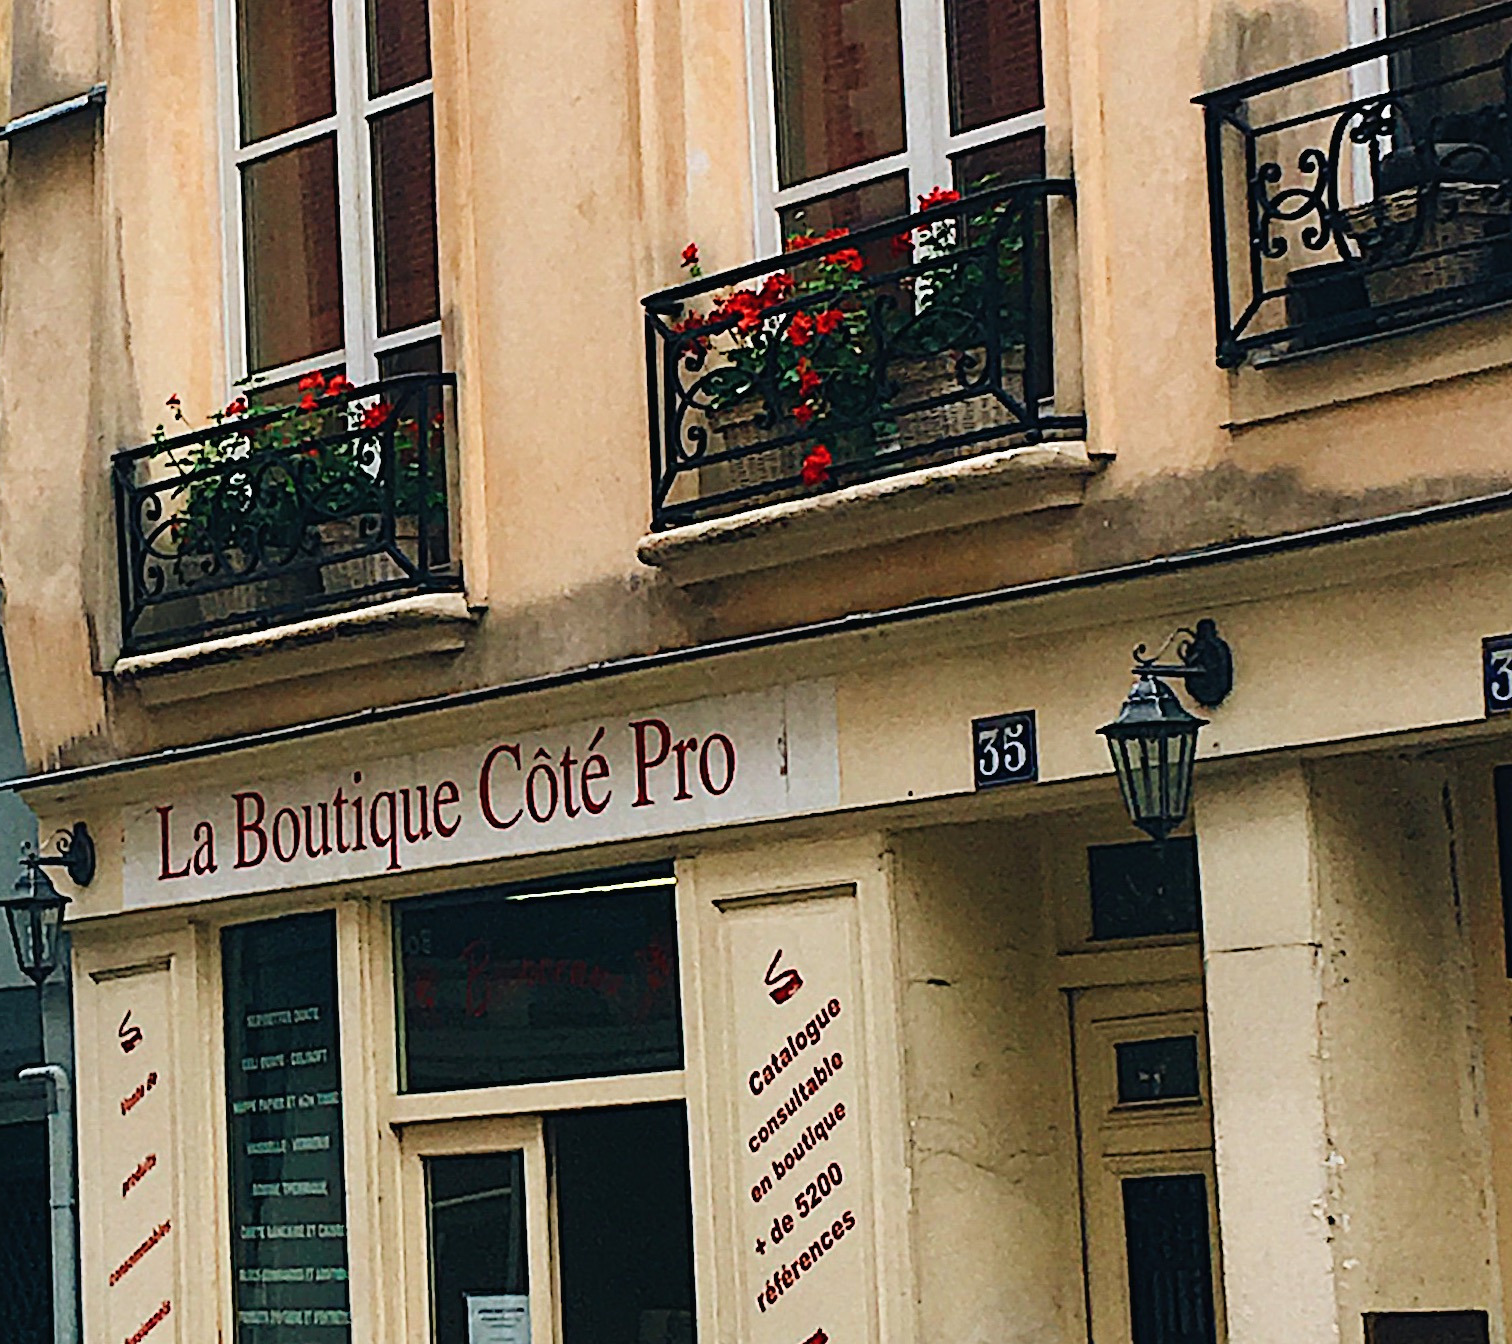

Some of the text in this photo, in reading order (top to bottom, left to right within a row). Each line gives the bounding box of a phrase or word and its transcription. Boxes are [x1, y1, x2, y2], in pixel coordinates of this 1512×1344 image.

[154, 718, 736, 881] La Boutique Côté Pro
[978, 723, 1027, 776] 35
[748, 998, 841, 1096] Catalogue
[748, 1052, 844, 1153] consultable
[750, 1102, 846, 1203] en boutique
[770, 1214, 794, 1245] de
[794, 1162, 843, 1219] 5200
[757, 1210, 856, 1313] références
